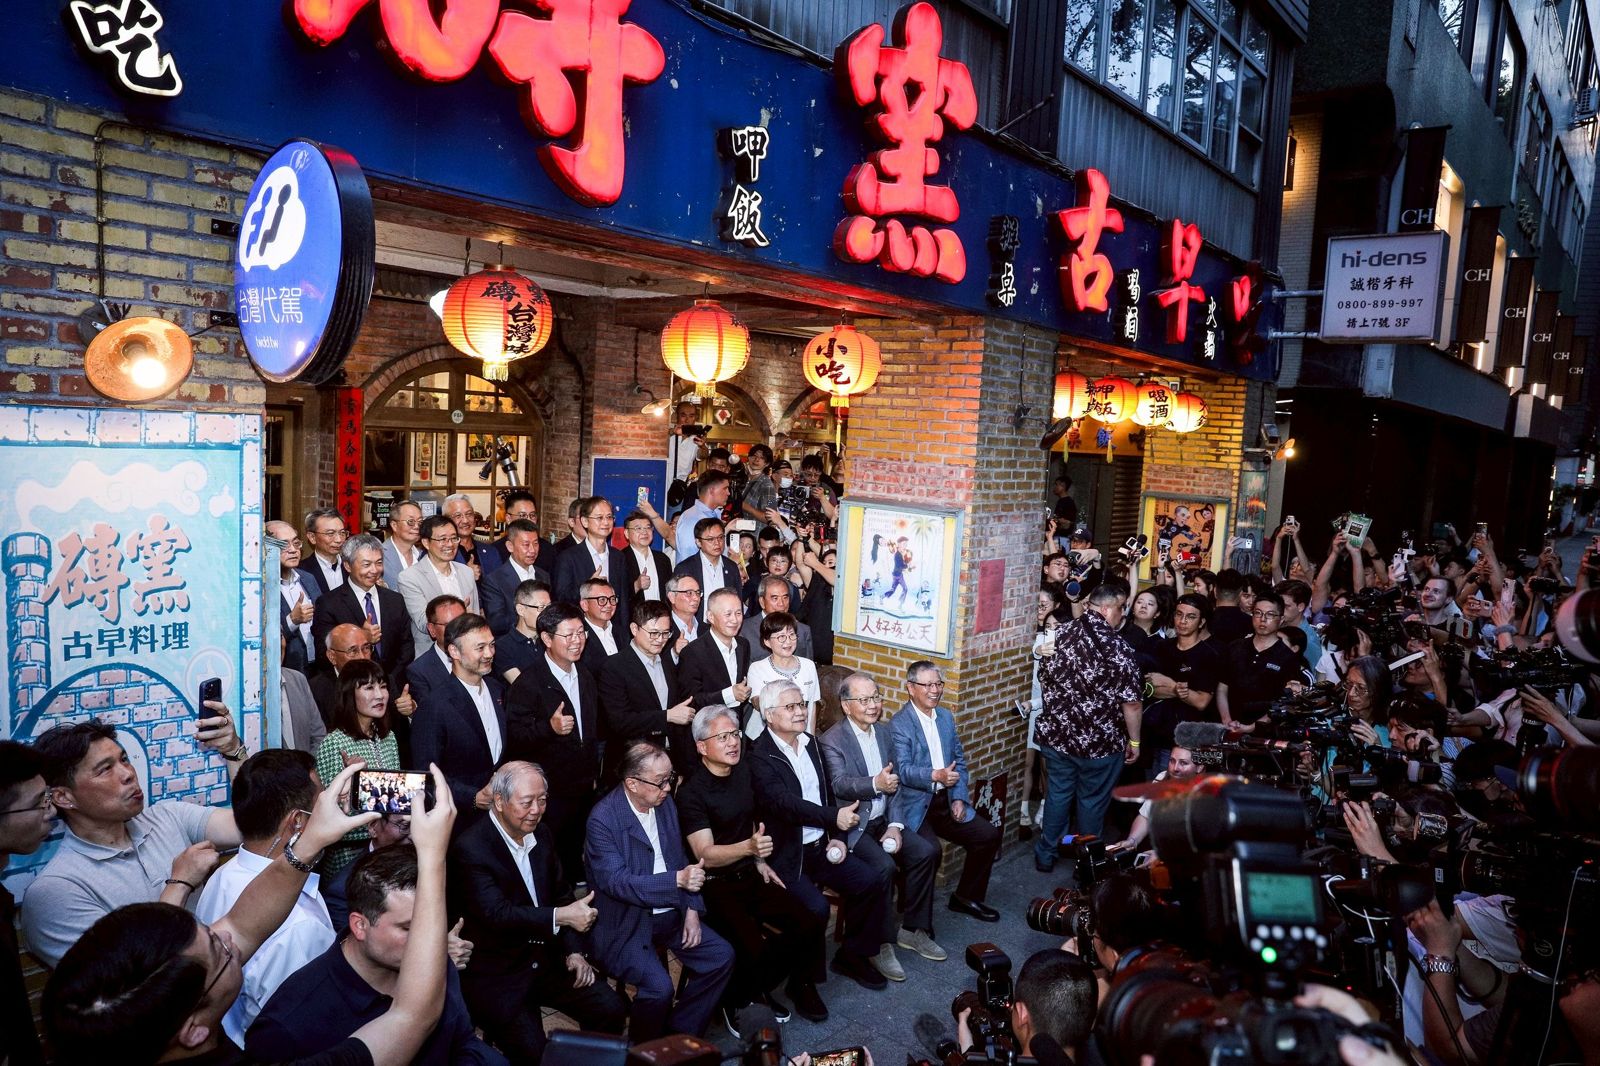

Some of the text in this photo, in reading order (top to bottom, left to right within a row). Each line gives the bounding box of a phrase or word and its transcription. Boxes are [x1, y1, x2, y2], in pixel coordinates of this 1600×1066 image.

[69, 0, 183, 97] 吃
[728, 126, 770, 247] 呷飯
[1401, 208, 1434, 225] CH
[1341, 250, 1427, 268] hi-dens
[1350, 275, 1414, 291] 誠楷牙科
[1464, 269, 1491, 282] CH
[238, 286, 303, 324] 台灣代駕
[1337, 299, 1424, 310] 0800-899-997
[1504, 307, 1527, 318] CH
[1394, 317, 1410, 327] 3F
[1532, 333, 1552, 342] CH
[815, 338, 850, 385] 小吃
[1553, 352, 1570, 360] CH
[1148, 389, 1169, 419] 喝酒
[42, 513, 192, 624] 磚窯
[61, 621, 190, 661] 古早料理
